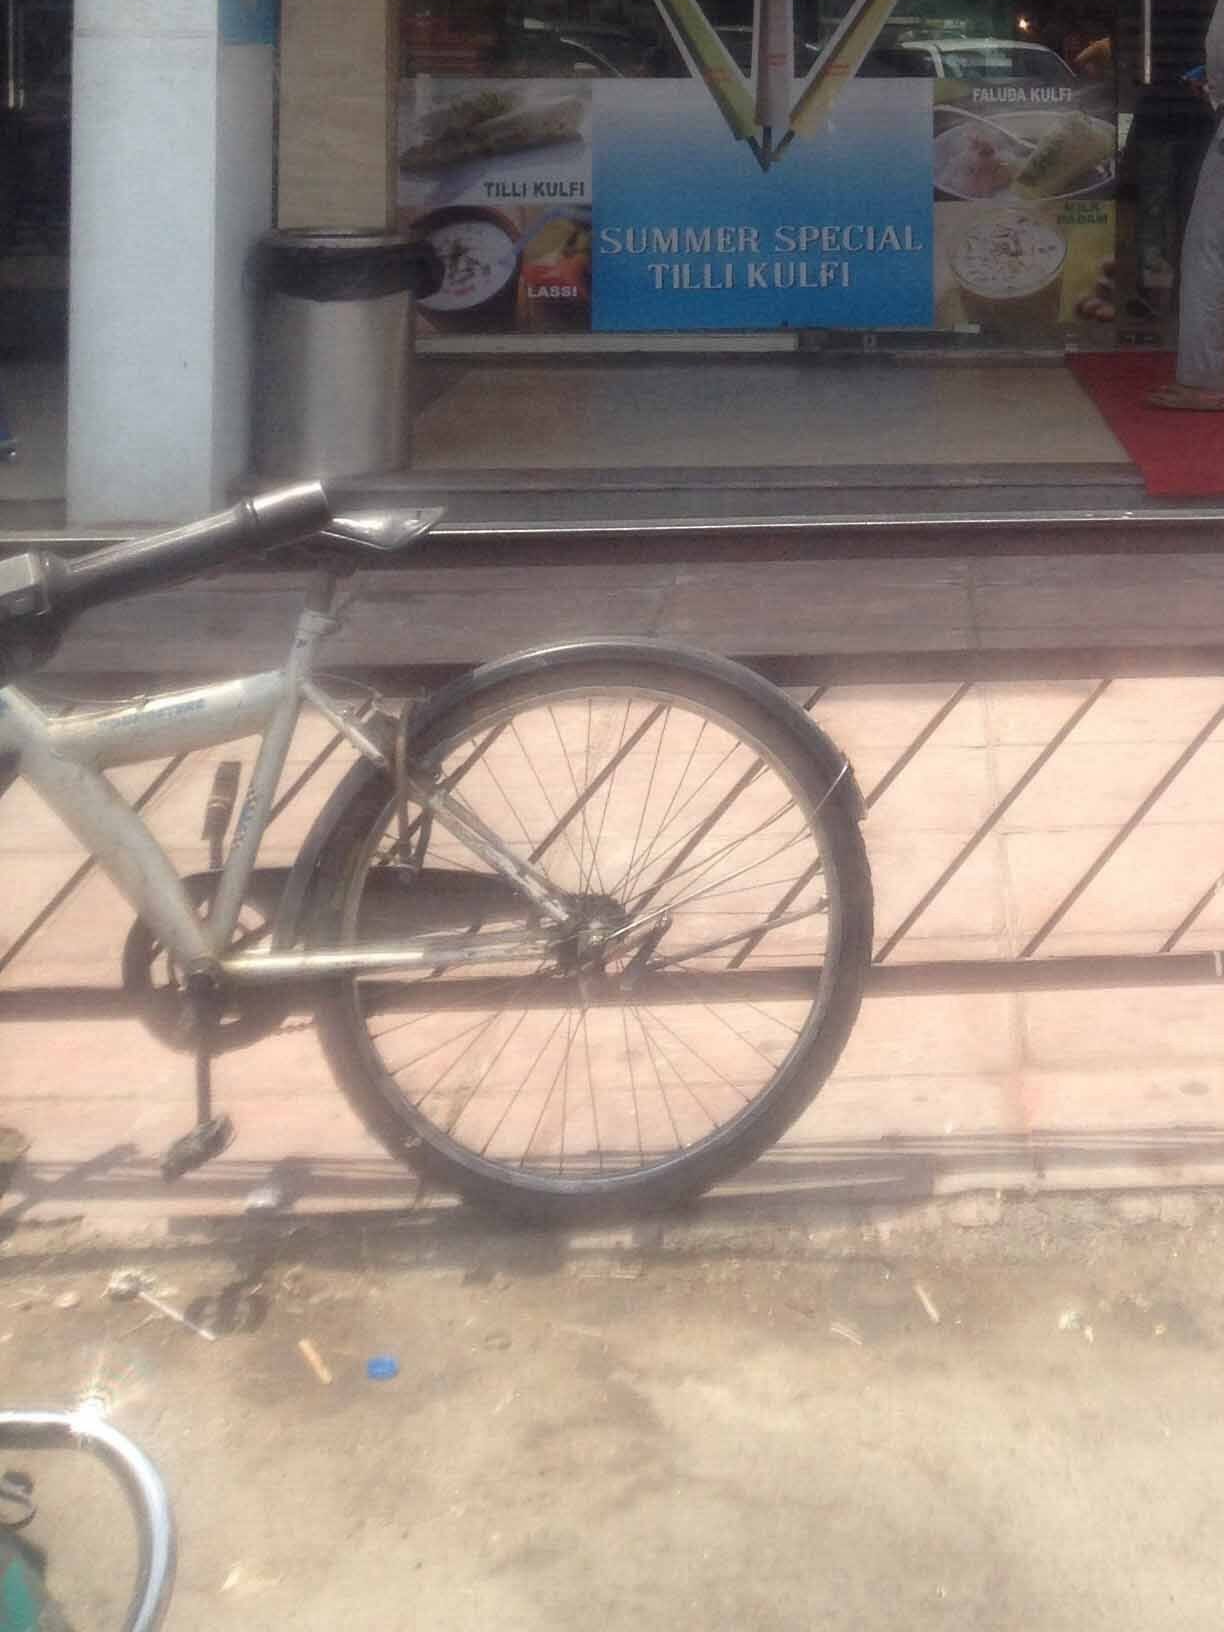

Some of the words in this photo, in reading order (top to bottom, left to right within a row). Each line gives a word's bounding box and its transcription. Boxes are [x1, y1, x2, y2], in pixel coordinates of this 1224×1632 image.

[1030, 87, 1073, 103] KULFI
[484, 181, 528, 198] TILLI
[533, 181, 585, 198] KULFI
[599, 225, 761, 255] SUMMER
[774, 224, 924, 253] SPECIAL
[647, 263, 735, 289] TILLI
[747, 260, 850, 289] KULFI
[527, 285, 578, 299] LASSI
